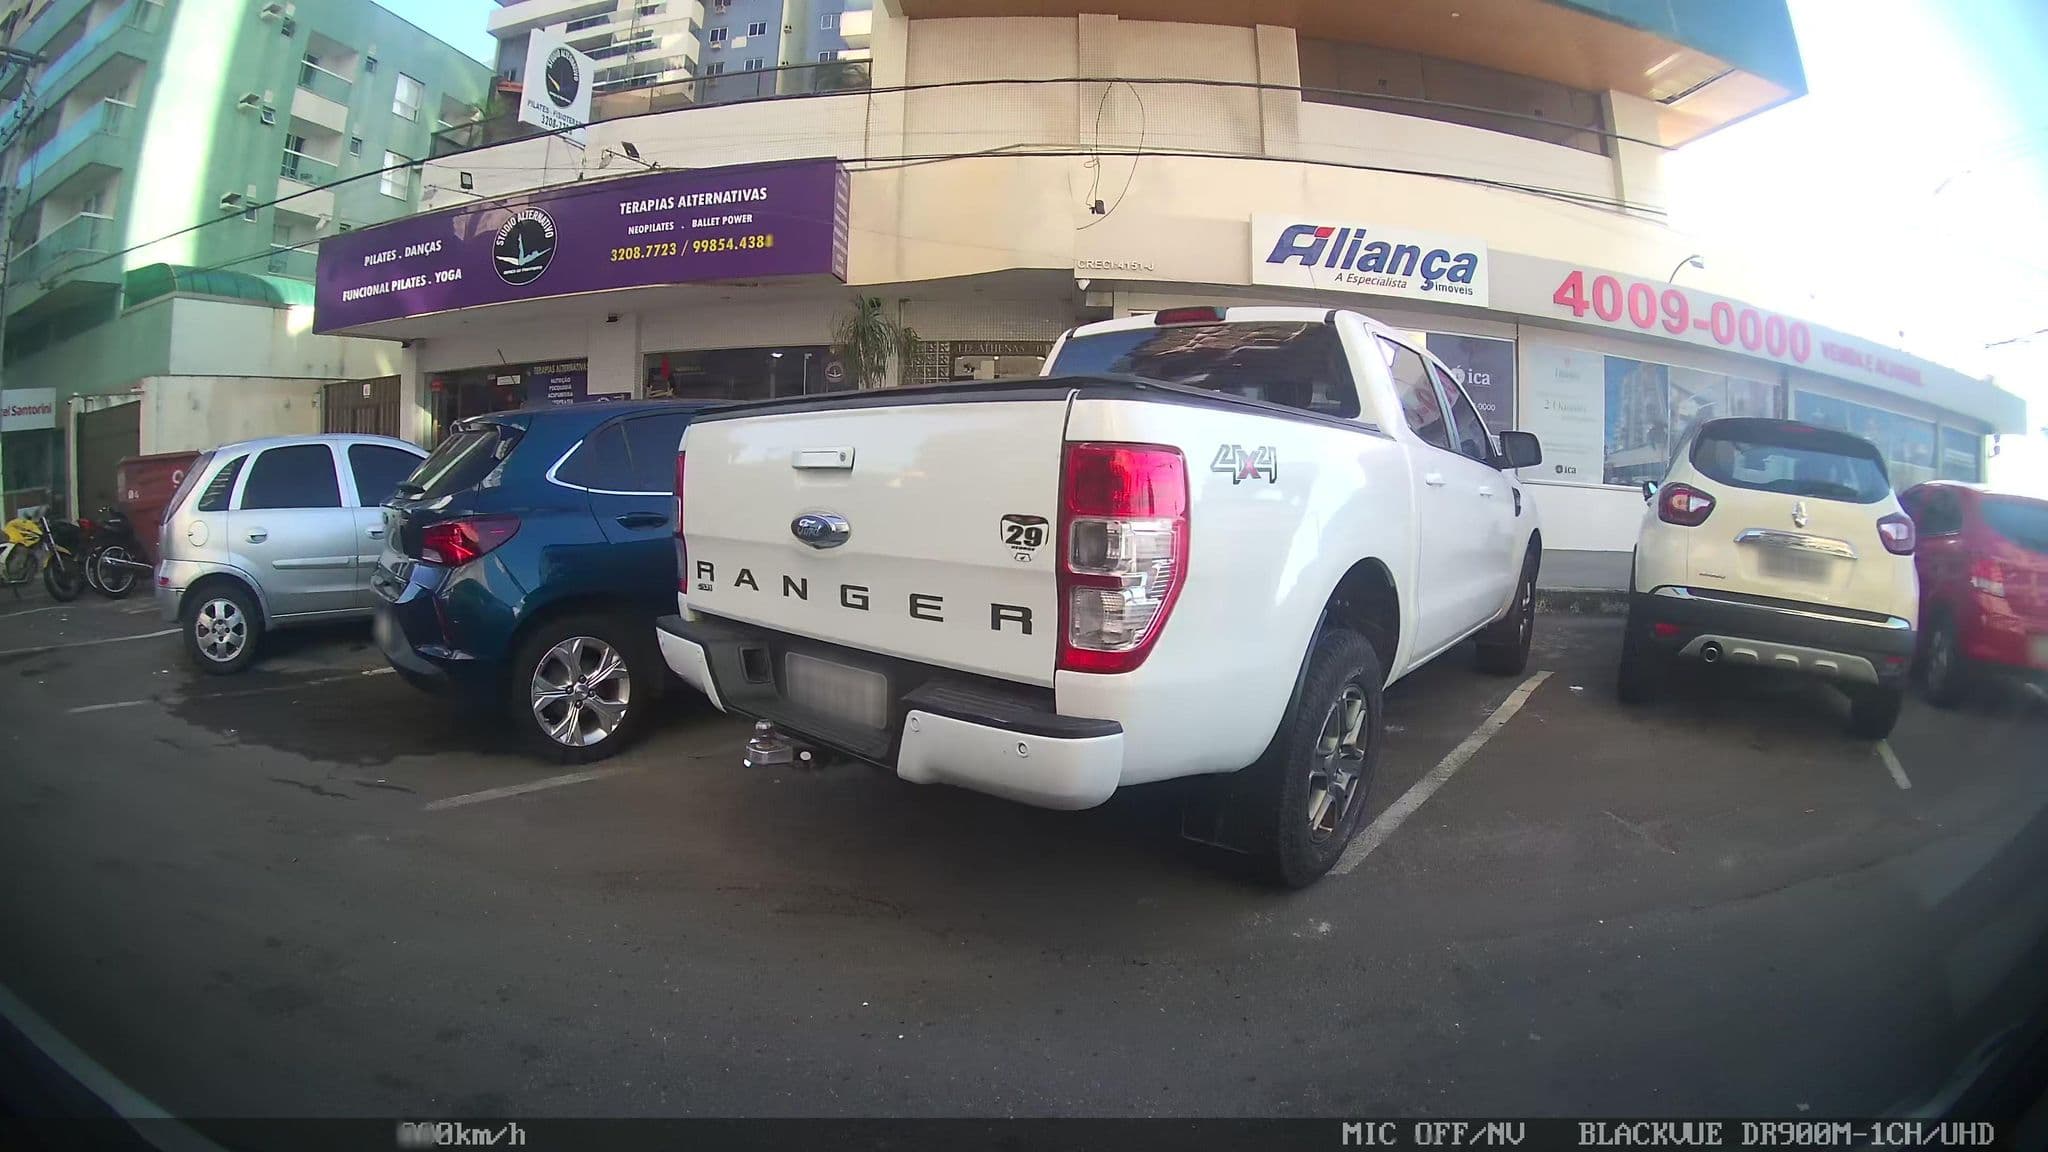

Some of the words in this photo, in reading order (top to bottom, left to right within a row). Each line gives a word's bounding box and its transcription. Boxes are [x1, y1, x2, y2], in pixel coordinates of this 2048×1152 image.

[620, 197, 675, 215] TERAPIAS
[678, 187, 768, 208] ALTERNATIVAS
[496, 217, 517, 246] STUDIO
[517, 209, 554, 239] ALTERNATIVO
[628, 221, 675, 235] NEOPILATES
[692, 216, 720, 228] BALLET
[722, 214, 753, 225] POWER
[364, 249, 397, 267] PILATES
[405, 240, 442, 257] DANÇAS
[610, 242, 677, 262] 3208.7723
[693, 234, 774, 254] 99854.438
[1266, 223, 1479, 291] Aliança
[342, 281, 390, 302] FUNCIONAL
[391, 275, 426, 292] PILATES
[435, 268, 462, 284] YOGA
[1335, 272, 1343, 282] A
[1346, 273, 1408, 289] Especialista
[1552, 270, 1812, 364] 4009-0000
[1468, 369, 1491, 386] ica
[12, 403, 52, 416] Santorini
[1005, 524, 1043, 547] 29
[696, 559, 1034, 636] RANGER
